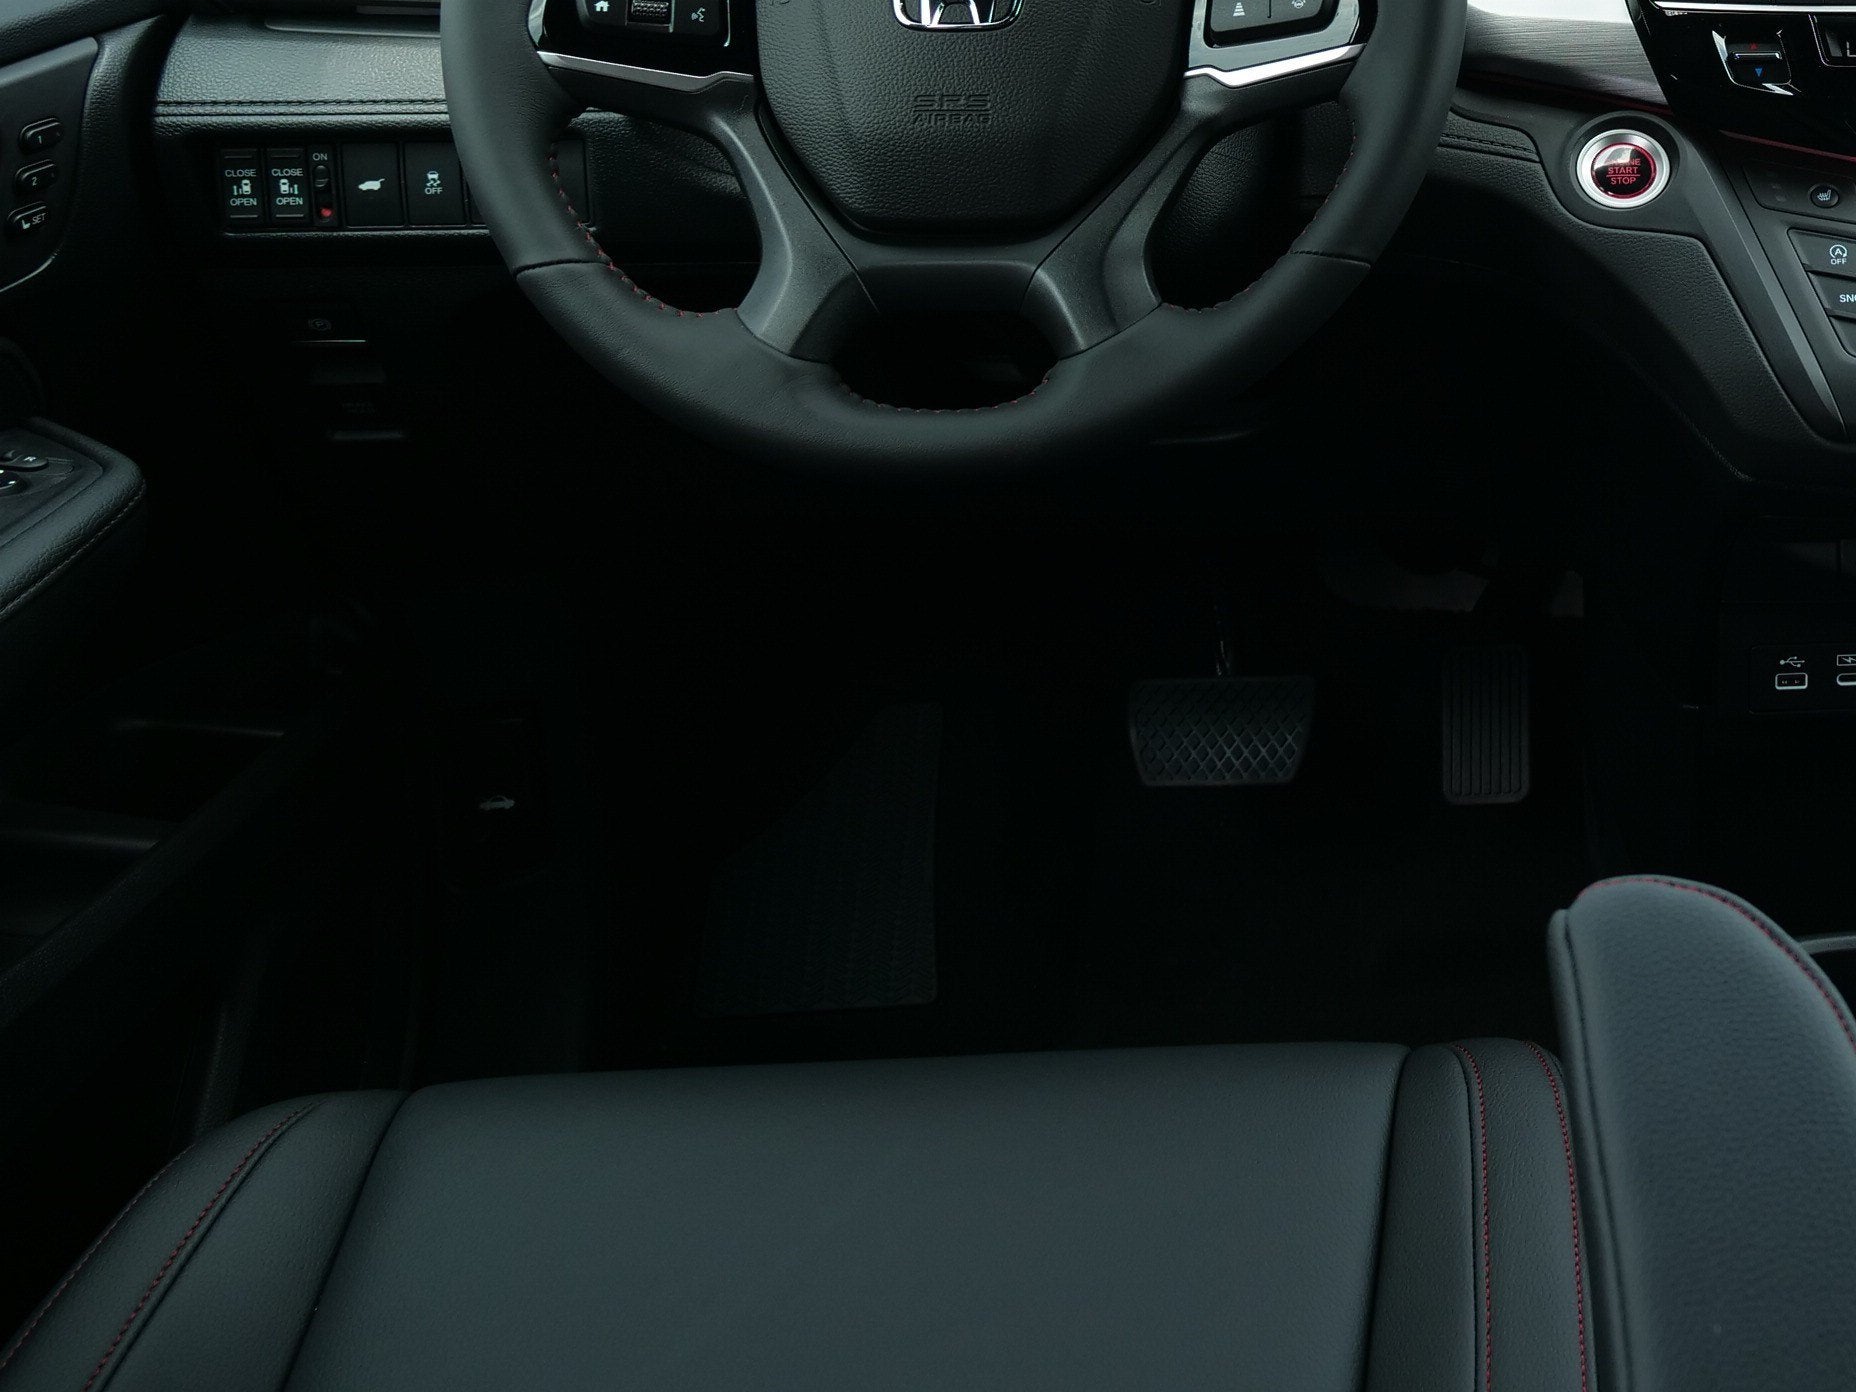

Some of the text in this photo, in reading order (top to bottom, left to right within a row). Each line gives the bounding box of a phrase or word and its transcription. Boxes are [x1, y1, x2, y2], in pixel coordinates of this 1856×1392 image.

[312, 153, 328, 161] ON
[224, 169, 257, 177] CLOSE
[271, 168, 304, 177] CLOSE
[1610, 177, 1637, 185] STOP
[424, 187, 443, 195] OFF
[230, 197, 258, 206] OPEN
[275, 197, 303, 206] OPEN
[32, 212, 47, 225] SET
